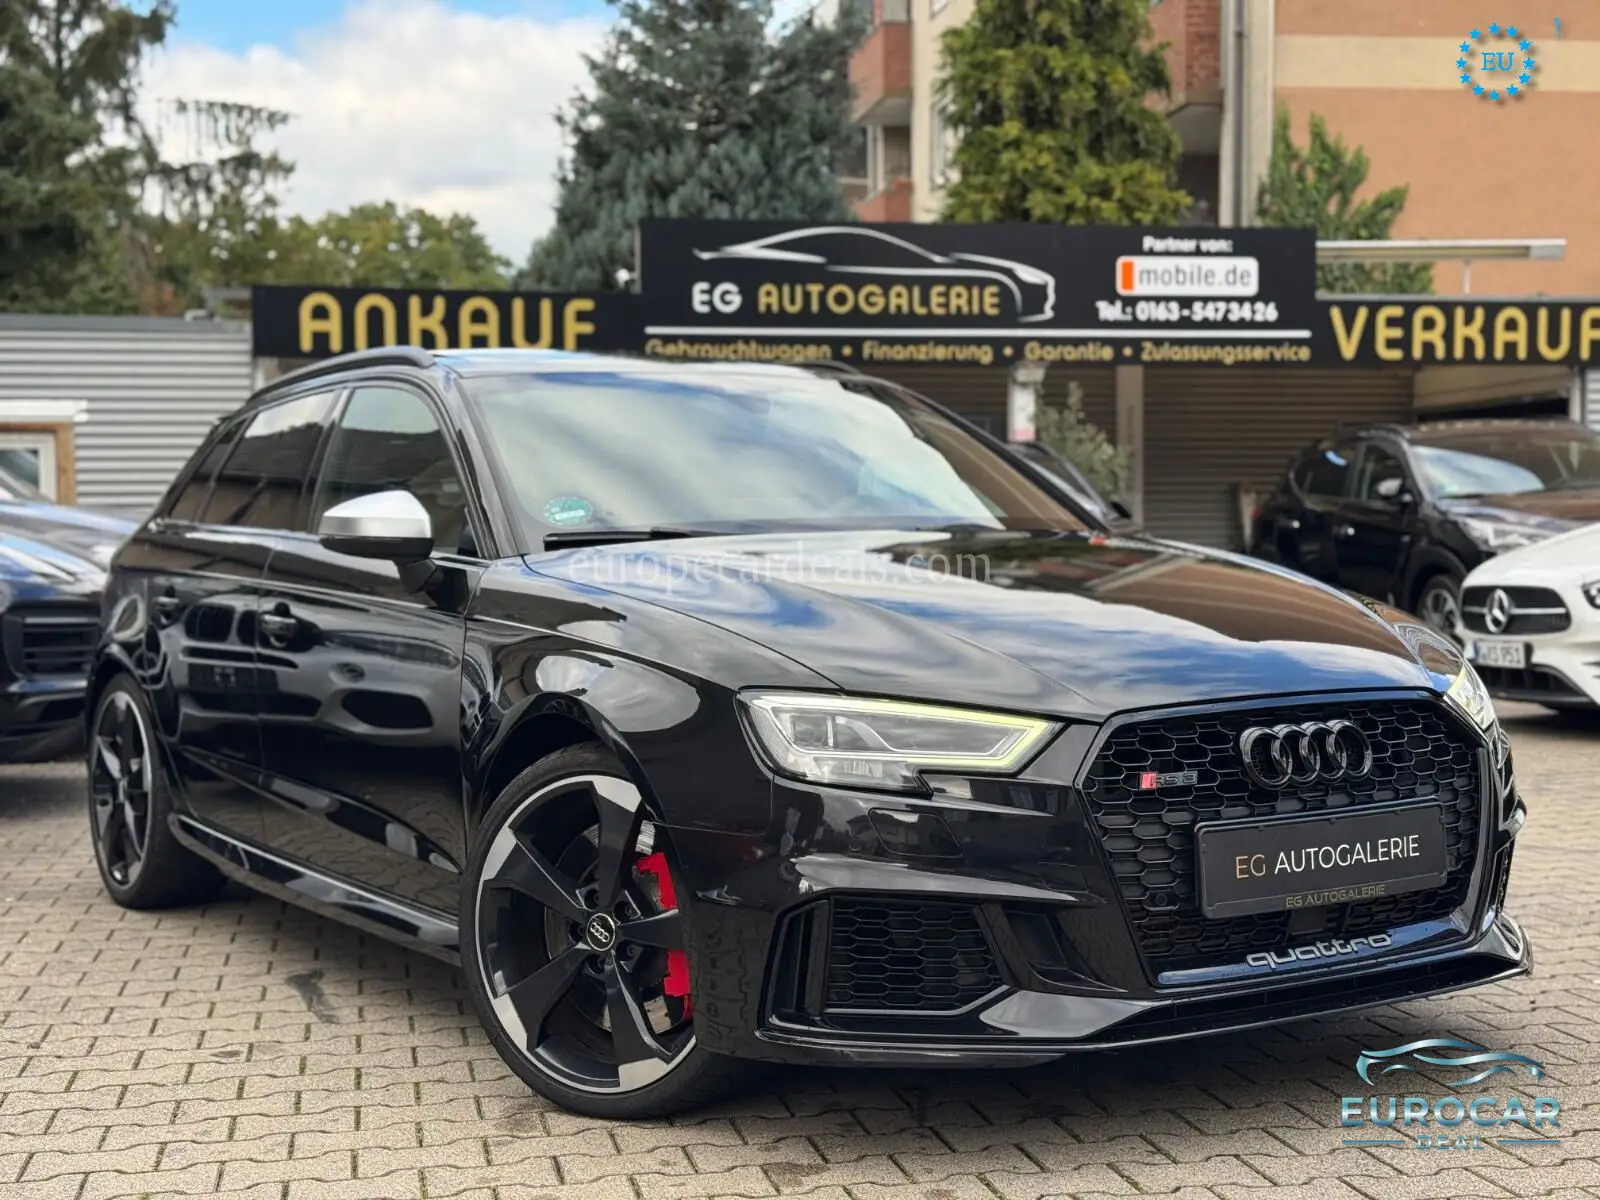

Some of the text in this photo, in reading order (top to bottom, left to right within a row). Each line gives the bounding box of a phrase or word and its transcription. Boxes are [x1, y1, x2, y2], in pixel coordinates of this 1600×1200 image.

[1142, 236, 1234, 253] Partner von:
[1138, 264, 1253, 287] mobile.de
[691, 281, 1002, 316] EG AUTOGALERIE
[1135, 301, 1279, 322] 0163-5473426
[298, 290, 597, 352] ANKAUF
[1329, 304, 1600, 362] VERKAUF
[861, 340, 995, 366] Finanzierung
[1023, 341, 1115, 362] Garantie
[1139, 341, 1312, 366] Zulassungsservice
[1235, 834, 1421, 880] EG AUTOGALERIE
[1285, 883, 1387, 909] EG AUTOGALERIE
[1246, 932, 1393, 970] quattro
